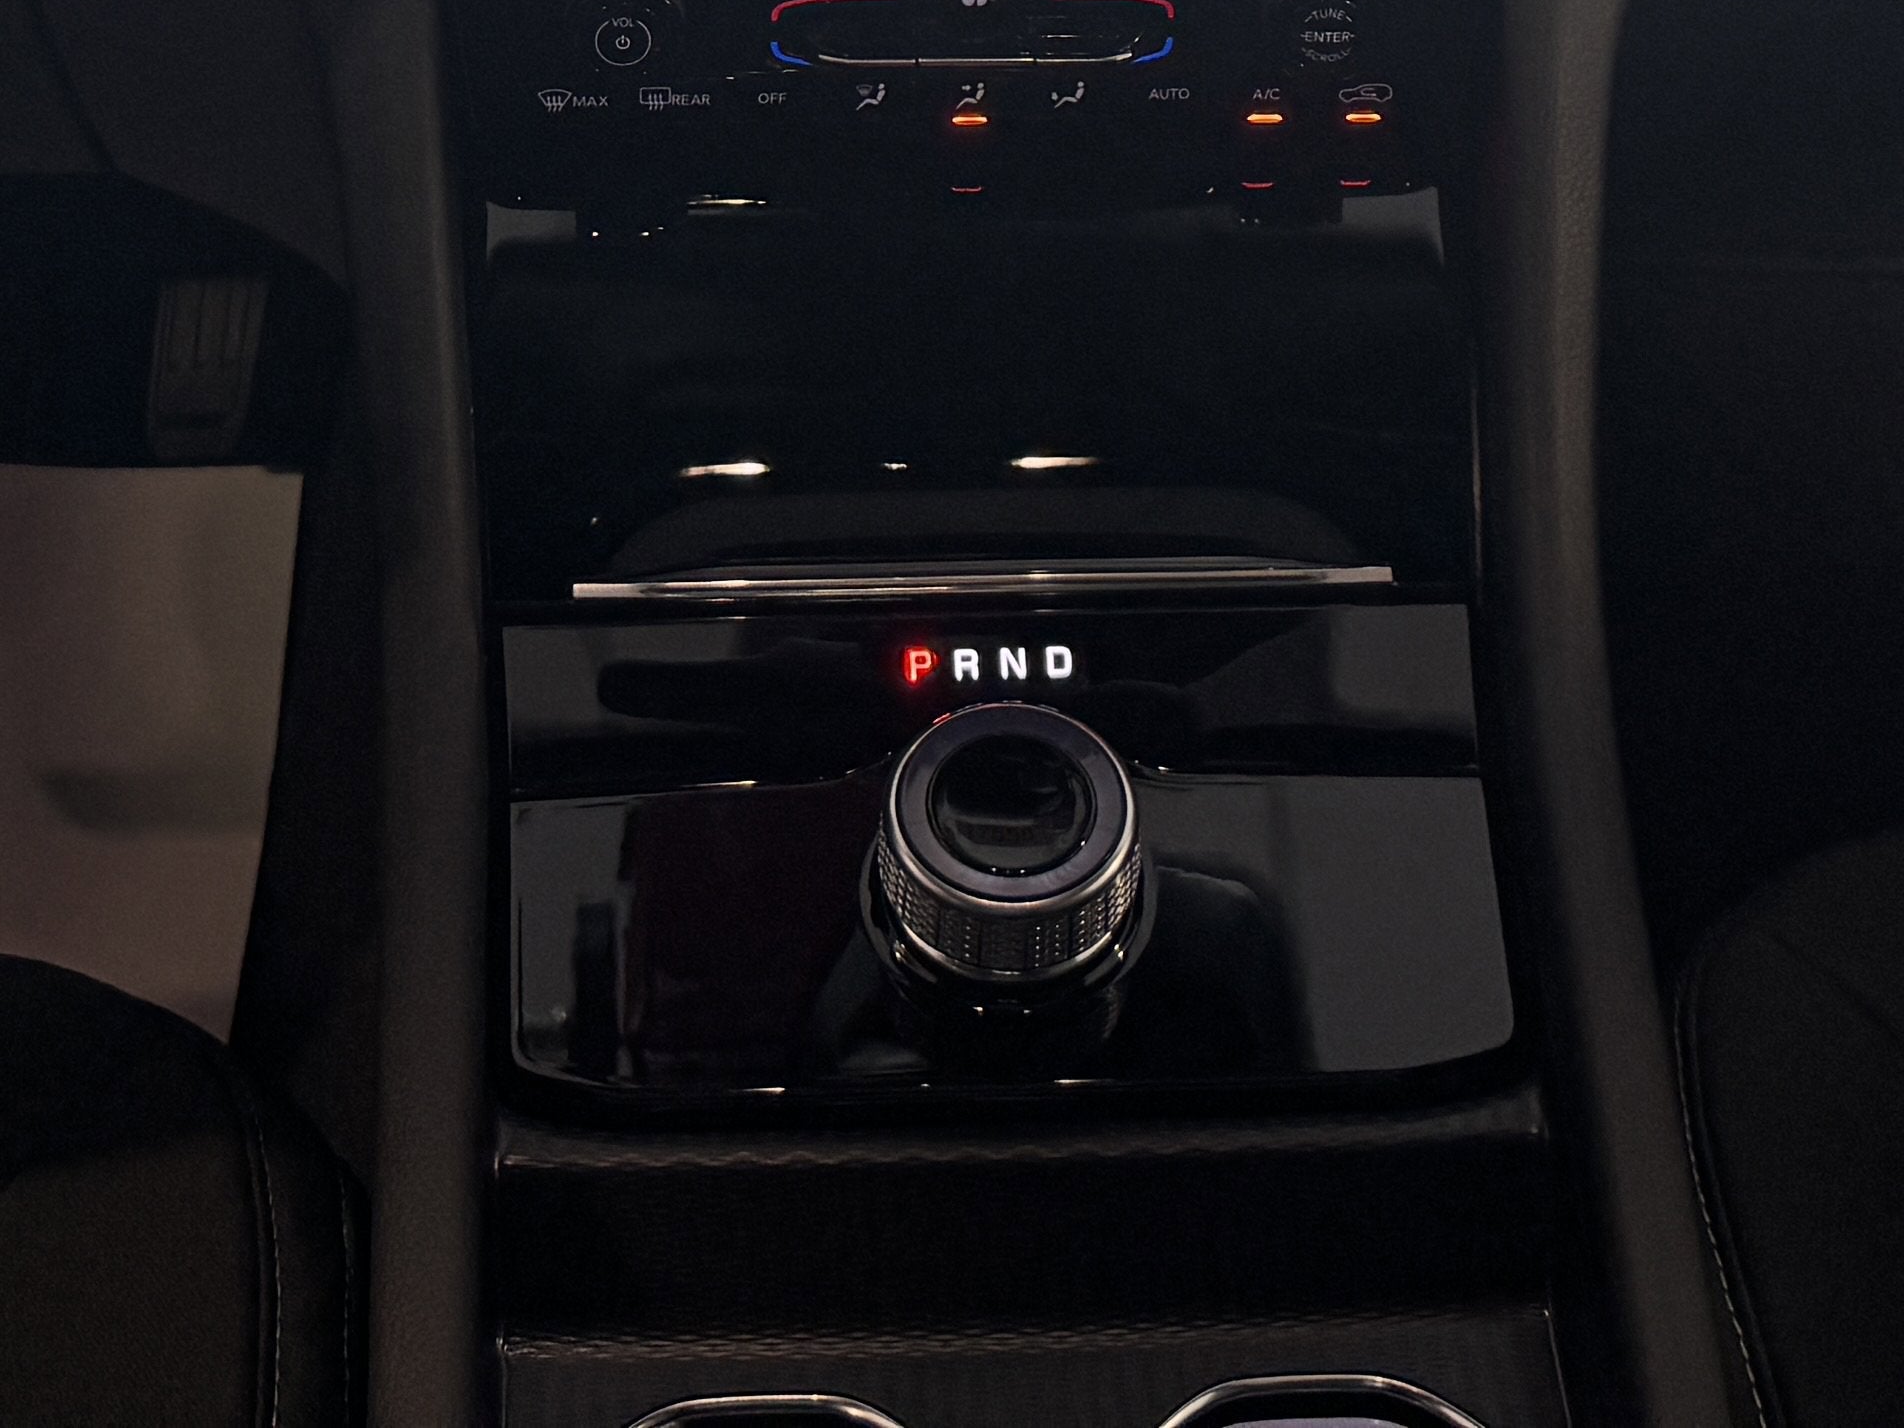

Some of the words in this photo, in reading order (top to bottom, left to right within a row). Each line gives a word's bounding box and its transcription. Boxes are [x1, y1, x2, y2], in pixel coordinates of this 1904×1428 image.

[1312, 7, 1345, 20] TUNE
[612, 17, 634, 28] VOL
[1305, 31, 1350, 42] ENTER
[757, 93, 787, 105] OFF
[1149, 87, 1190, 100] AUTO
[1253, 88, 1281, 100] A/C
[573, 95, 608, 107] MAX
[672, 94, 711, 106] REAR
[905, 647, 934, 683] P
[953, 648, 980, 682] R
[999, 647, 1027, 680] N
[1045, 645, 1073, 679] D
